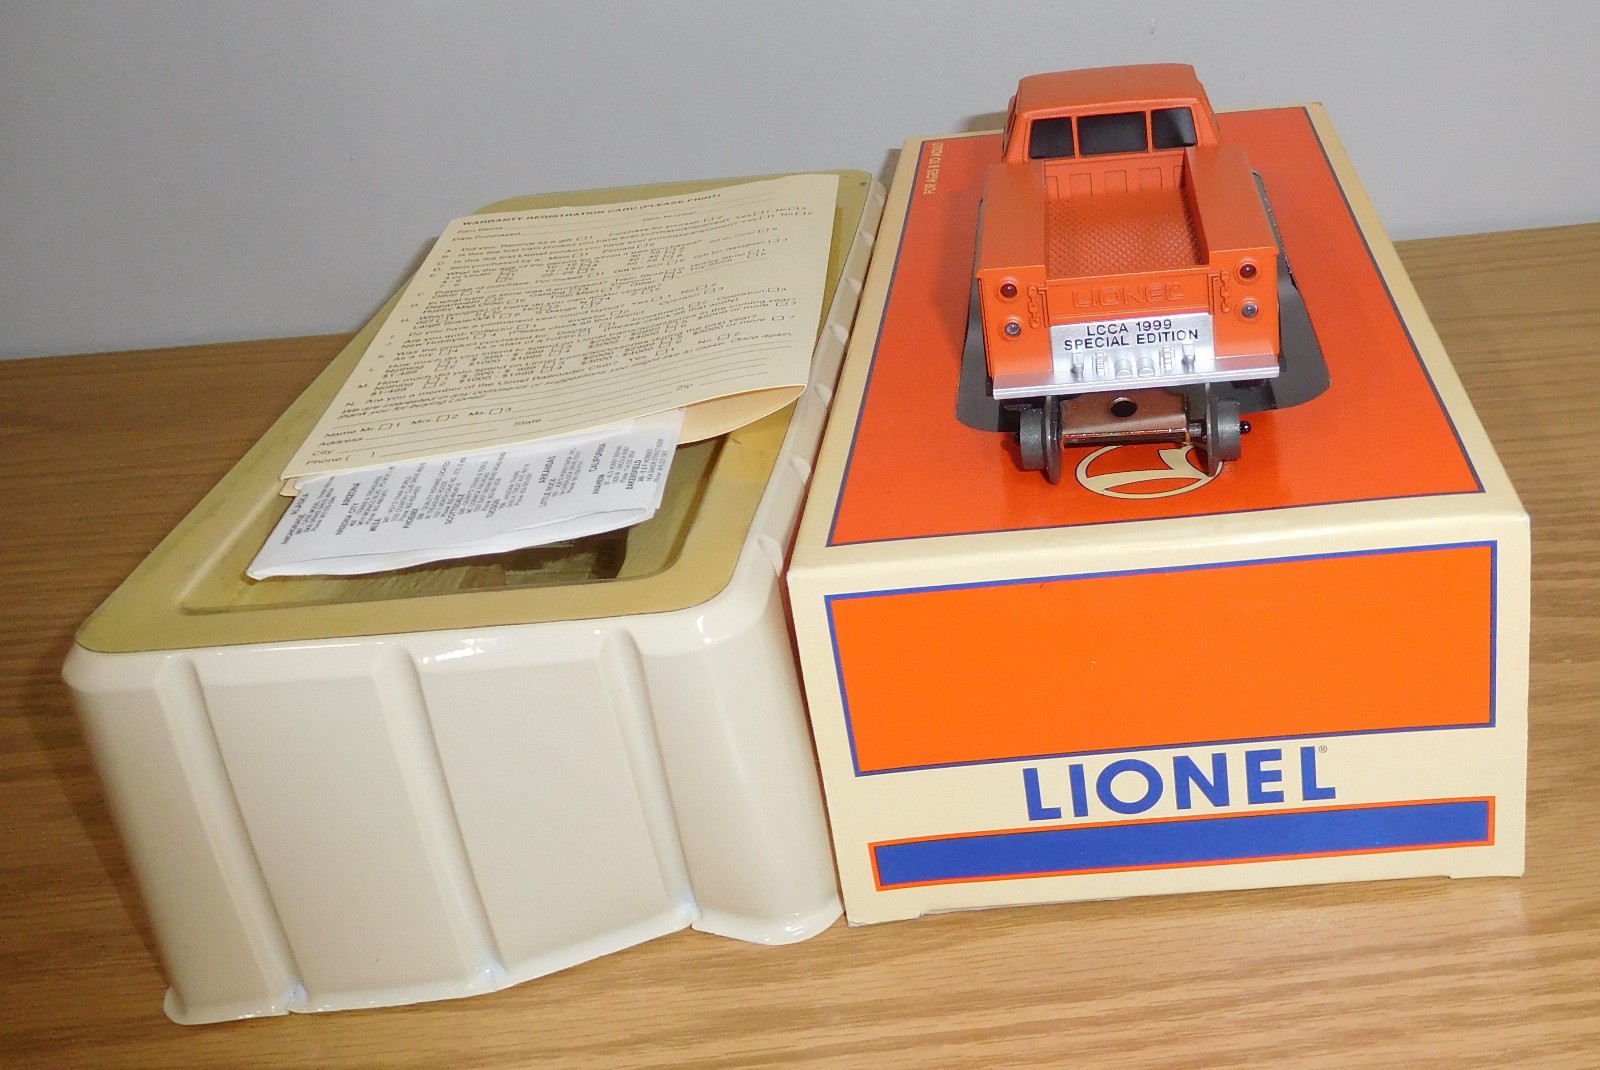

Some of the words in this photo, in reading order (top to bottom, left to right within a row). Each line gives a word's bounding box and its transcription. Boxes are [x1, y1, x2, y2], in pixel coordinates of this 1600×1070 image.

[463, 216, 524, 226] WARRANTY
[527, 210, 605, 220] REGISTRATION
[1071, 281, 1185, 309] LIONEL
[1063, 334, 1130, 352] SPECIAL
[1136, 328, 1200, 346] EDITION
[1086, 323, 1130, 338] LCCA
[1135, 318, 1173, 333] 1999
[1022, 745, 1337, 821] LIONEL
